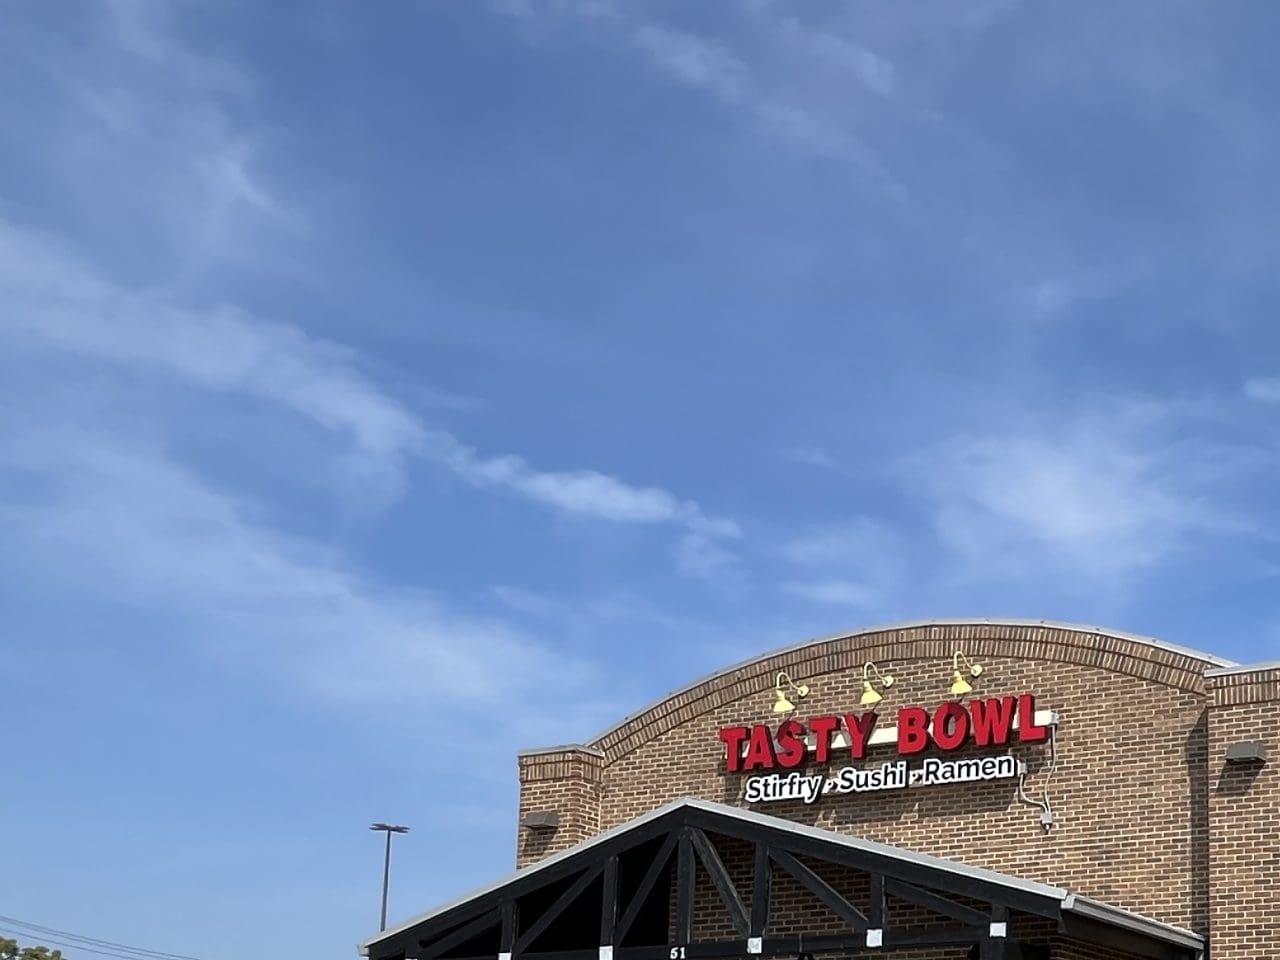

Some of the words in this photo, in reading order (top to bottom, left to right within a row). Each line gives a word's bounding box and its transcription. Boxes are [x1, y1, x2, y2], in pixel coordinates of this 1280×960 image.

[720, 711, 878, 772] TASTY
[897, 694, 1048, 754] BOWL
[747, 773, 821, 802] Stirfry
[839, 761, 906, 790] Sushi
[925, 758, 1013, 783] Ramen
